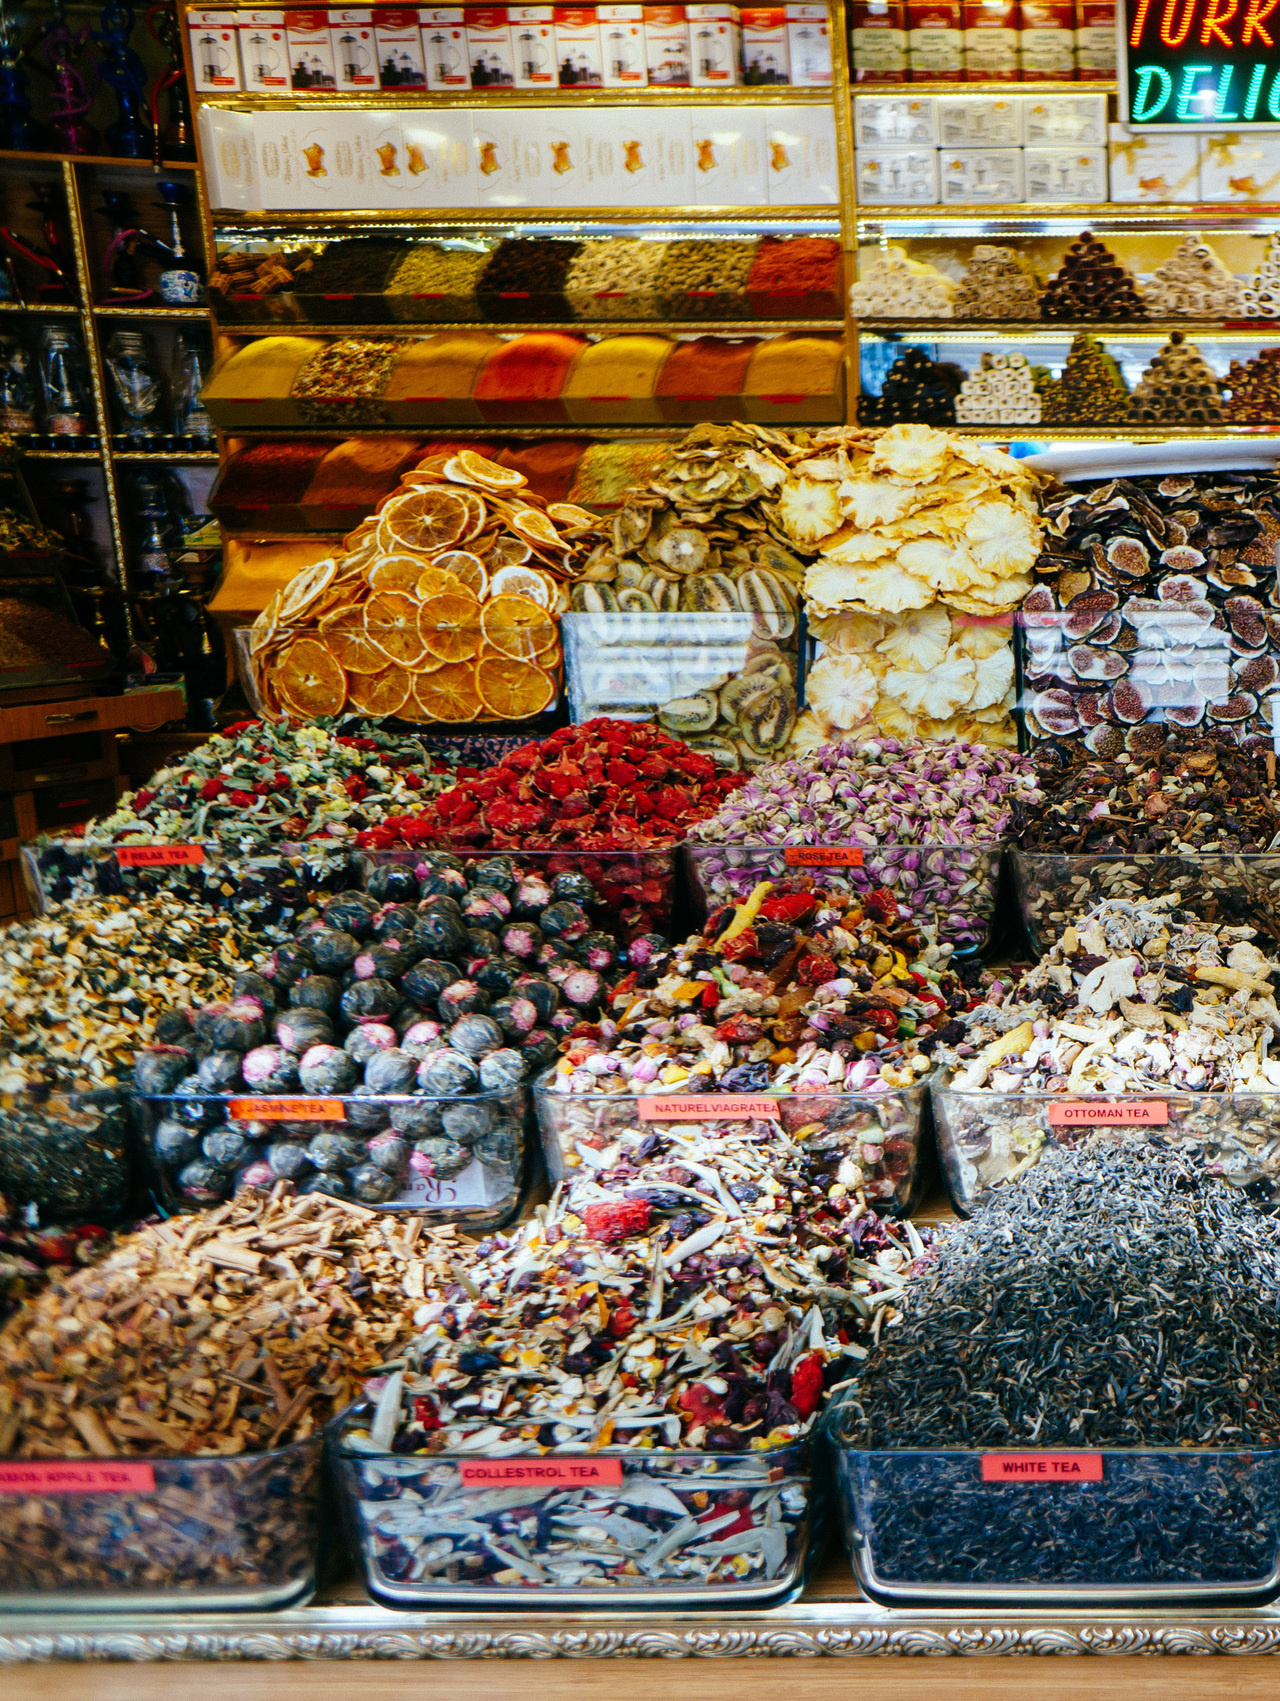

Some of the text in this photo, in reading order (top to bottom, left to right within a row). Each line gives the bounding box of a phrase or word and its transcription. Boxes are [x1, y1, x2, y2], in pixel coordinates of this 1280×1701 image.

[130, 849, 189, 861] RELAX TEA
[798, 852, 849, 861] ROSE TEA
[300, 1103, 327, 1114] TEA
[1064, 1108, 1150, 1118] OTTOMAN TEA
[464, 1466, 600, 1479] COLLESTROL TEA
[1003, 1462, 1081, 1473] WHITE TEA
[99, 1470, 132, 1482] TEA
